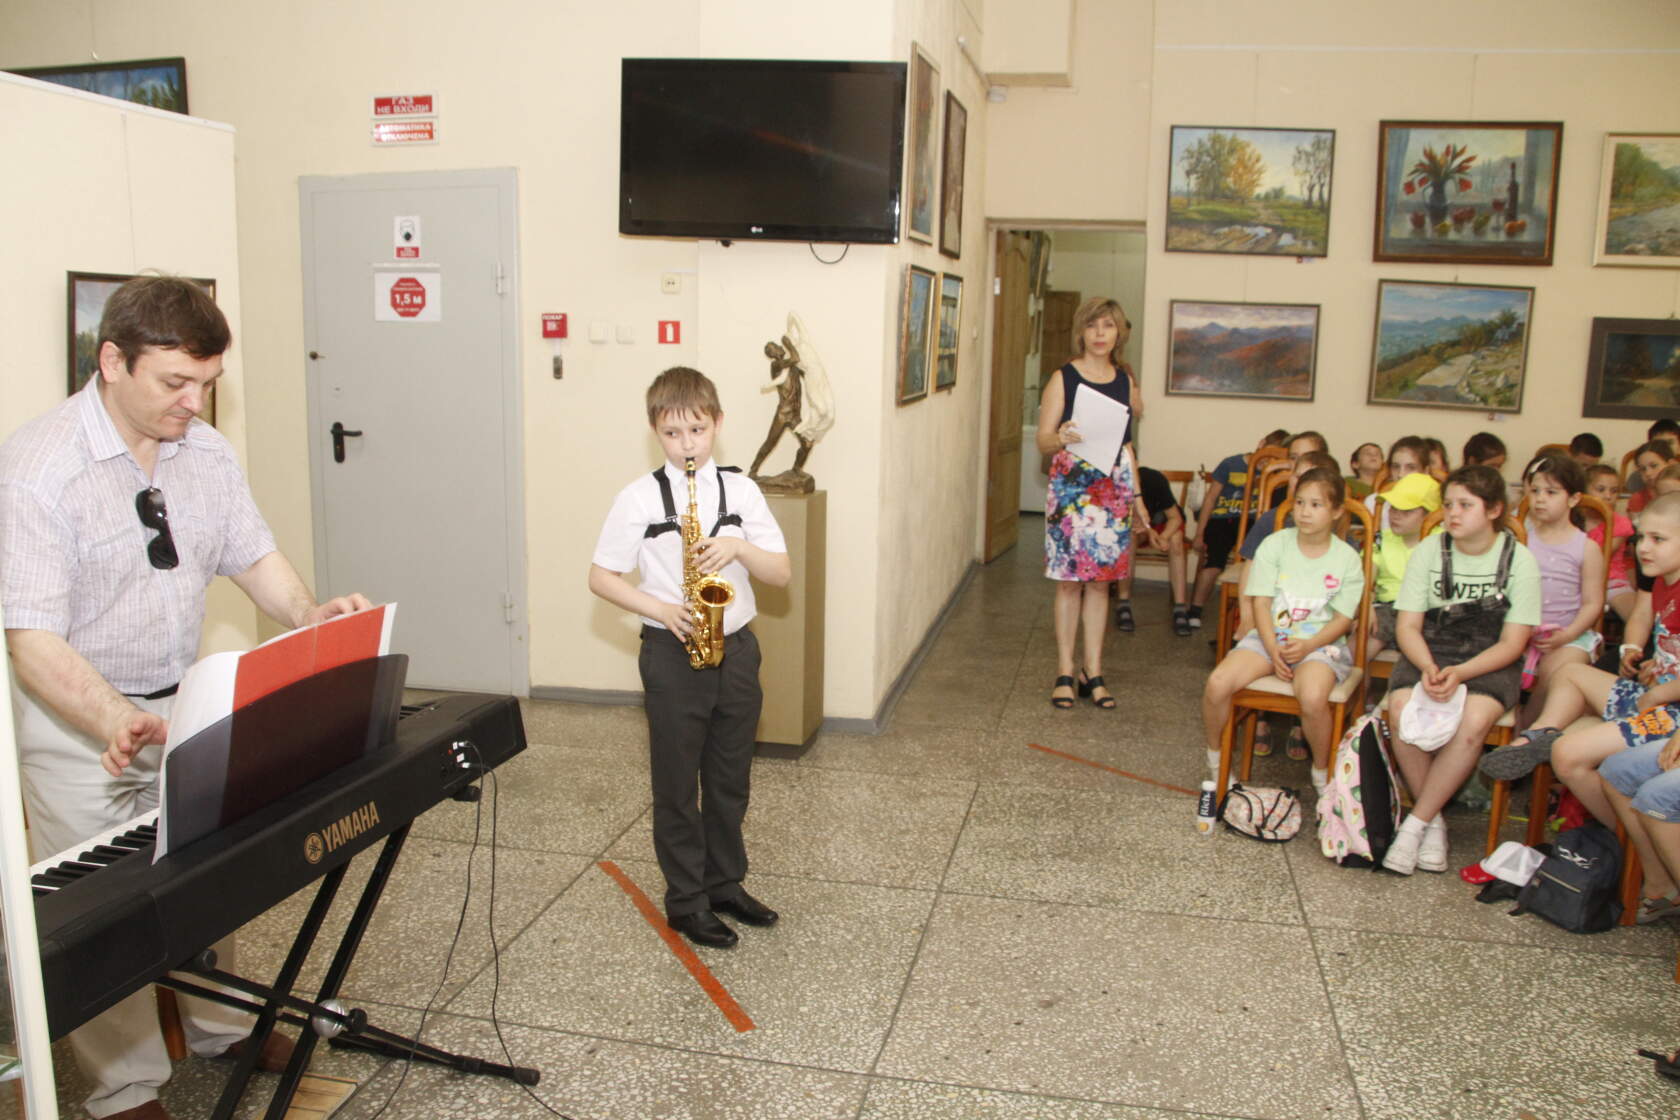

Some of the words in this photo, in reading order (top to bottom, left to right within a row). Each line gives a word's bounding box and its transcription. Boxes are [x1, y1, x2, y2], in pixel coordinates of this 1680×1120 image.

[391, 95, 414, 105] ГАЗ
[377, 105, 391, 114] НЕ
[393, 103, 430, 113] ВХОДИ
[395, 293, 411, 306] 1,5
[321, 800, 380, 853] YAMAHA
